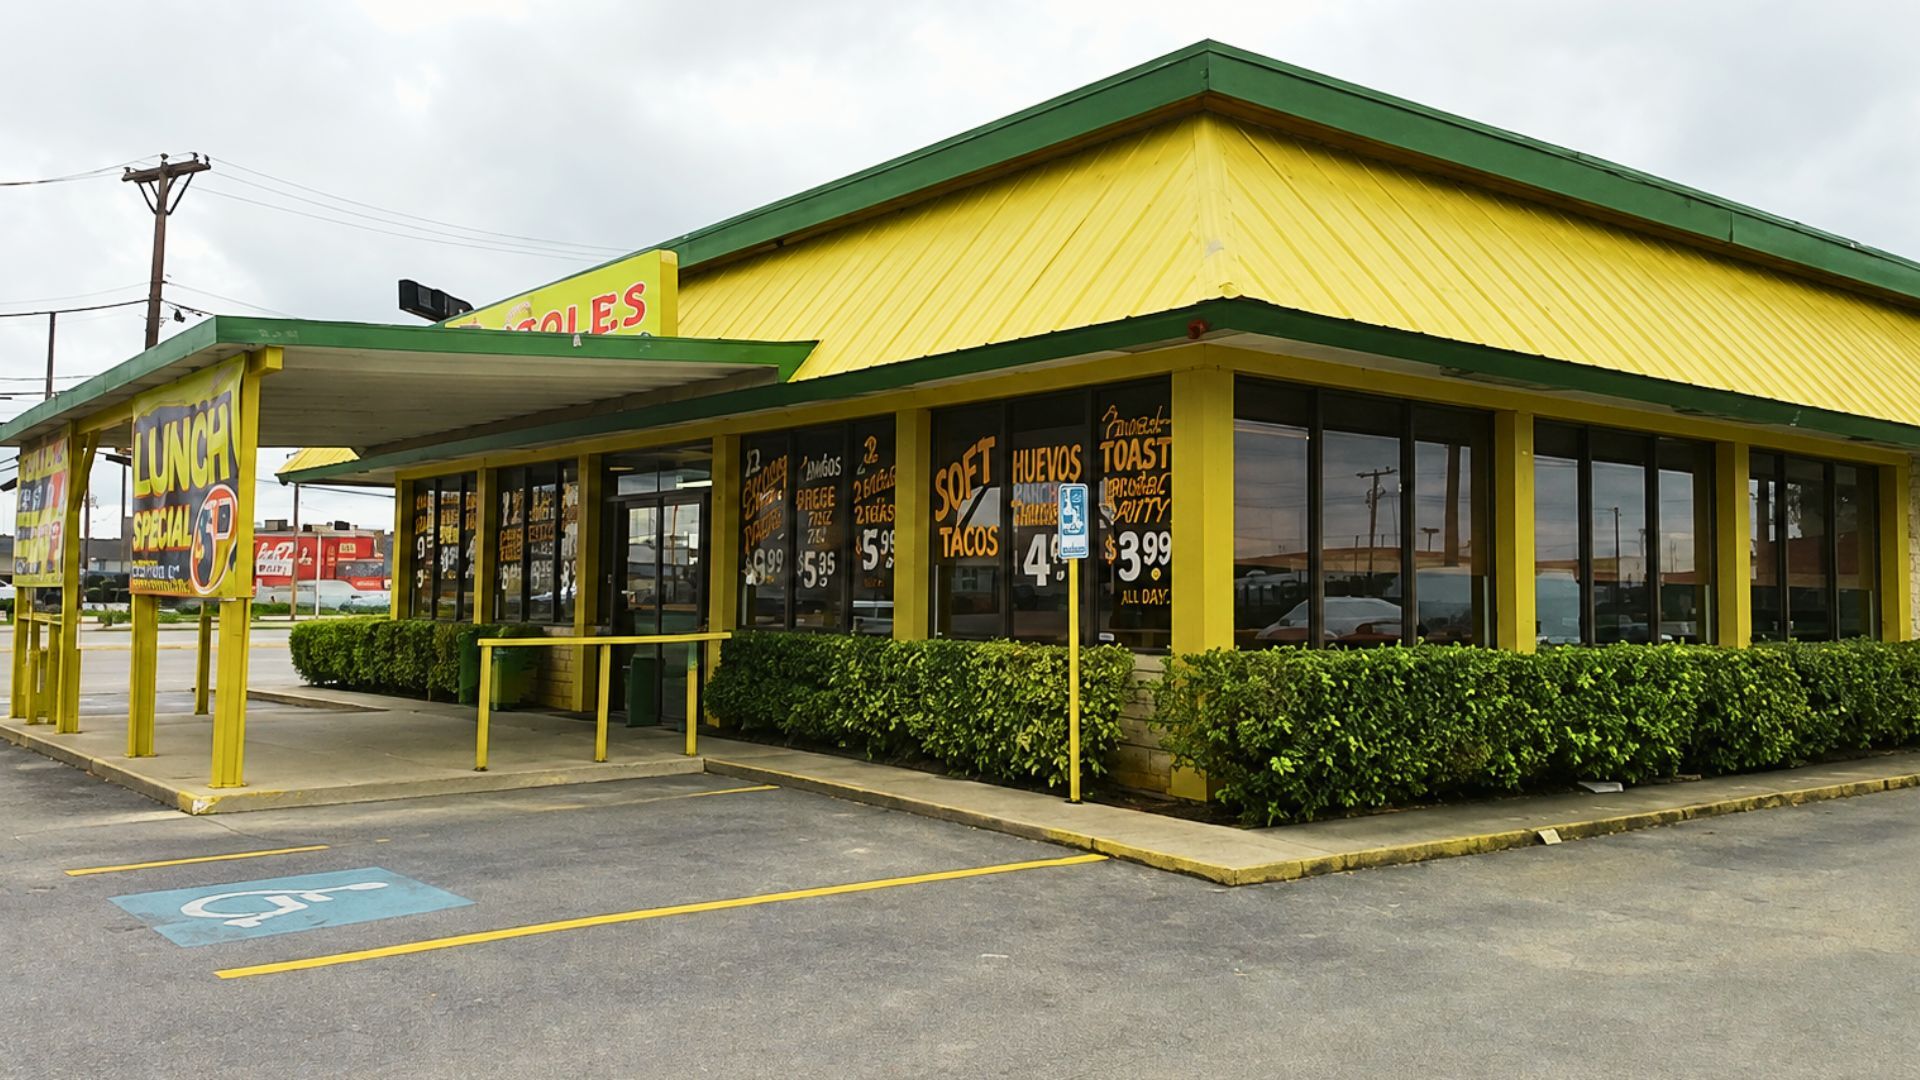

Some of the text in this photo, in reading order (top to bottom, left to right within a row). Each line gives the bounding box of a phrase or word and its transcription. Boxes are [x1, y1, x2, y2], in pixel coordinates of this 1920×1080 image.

[134, 402, 231, 498] LUNCH
[1012, 444, 1082, 483] HUEVOS
[1099, 436, 1172, 473] TOAST
[935, 436, 996, 522] SOFT
[132, 504, 193, 551] SPECIAL
[939, 526, 999, 558] TACOS
[1121, 590, 1139, 605] ALL
